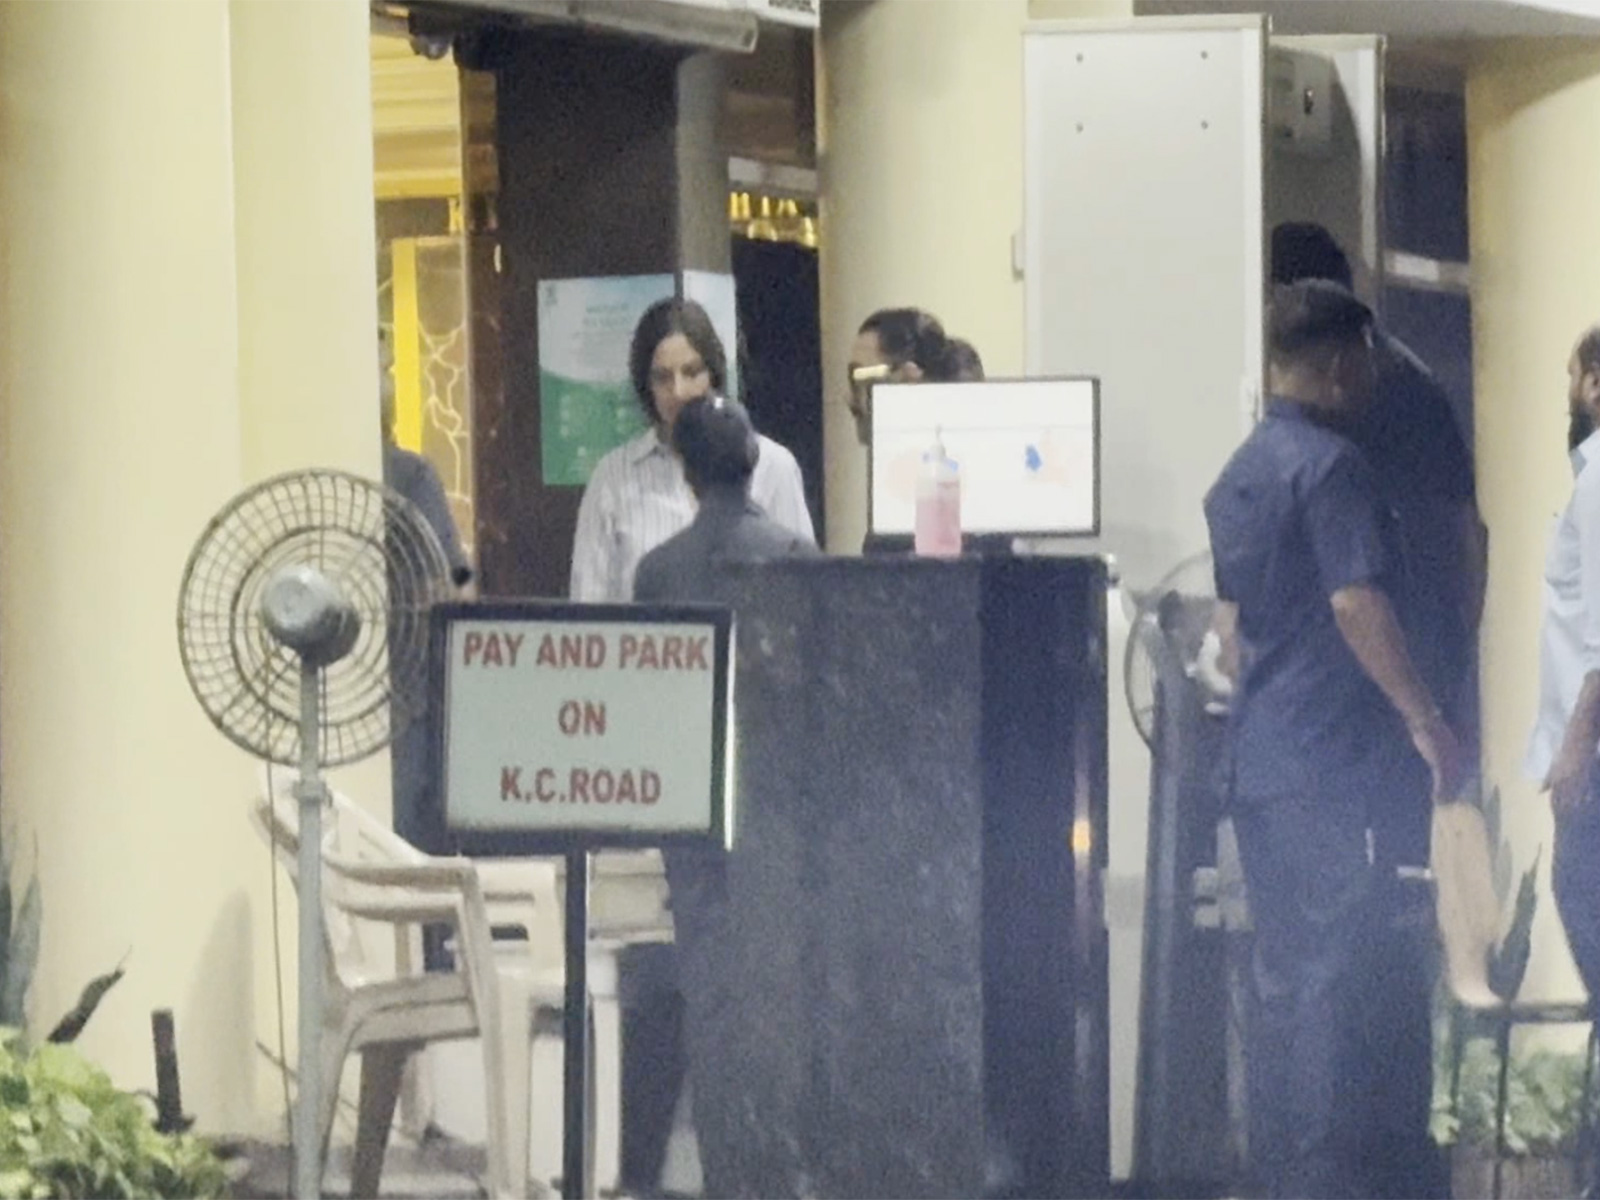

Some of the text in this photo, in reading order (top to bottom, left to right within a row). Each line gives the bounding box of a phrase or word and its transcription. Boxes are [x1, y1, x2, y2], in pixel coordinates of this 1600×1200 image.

[463, 631, 708, 670] PAY AND PARK
[558, 699, 606, 736] ON
[501, 766, 661, 804] K.C.ROAD
